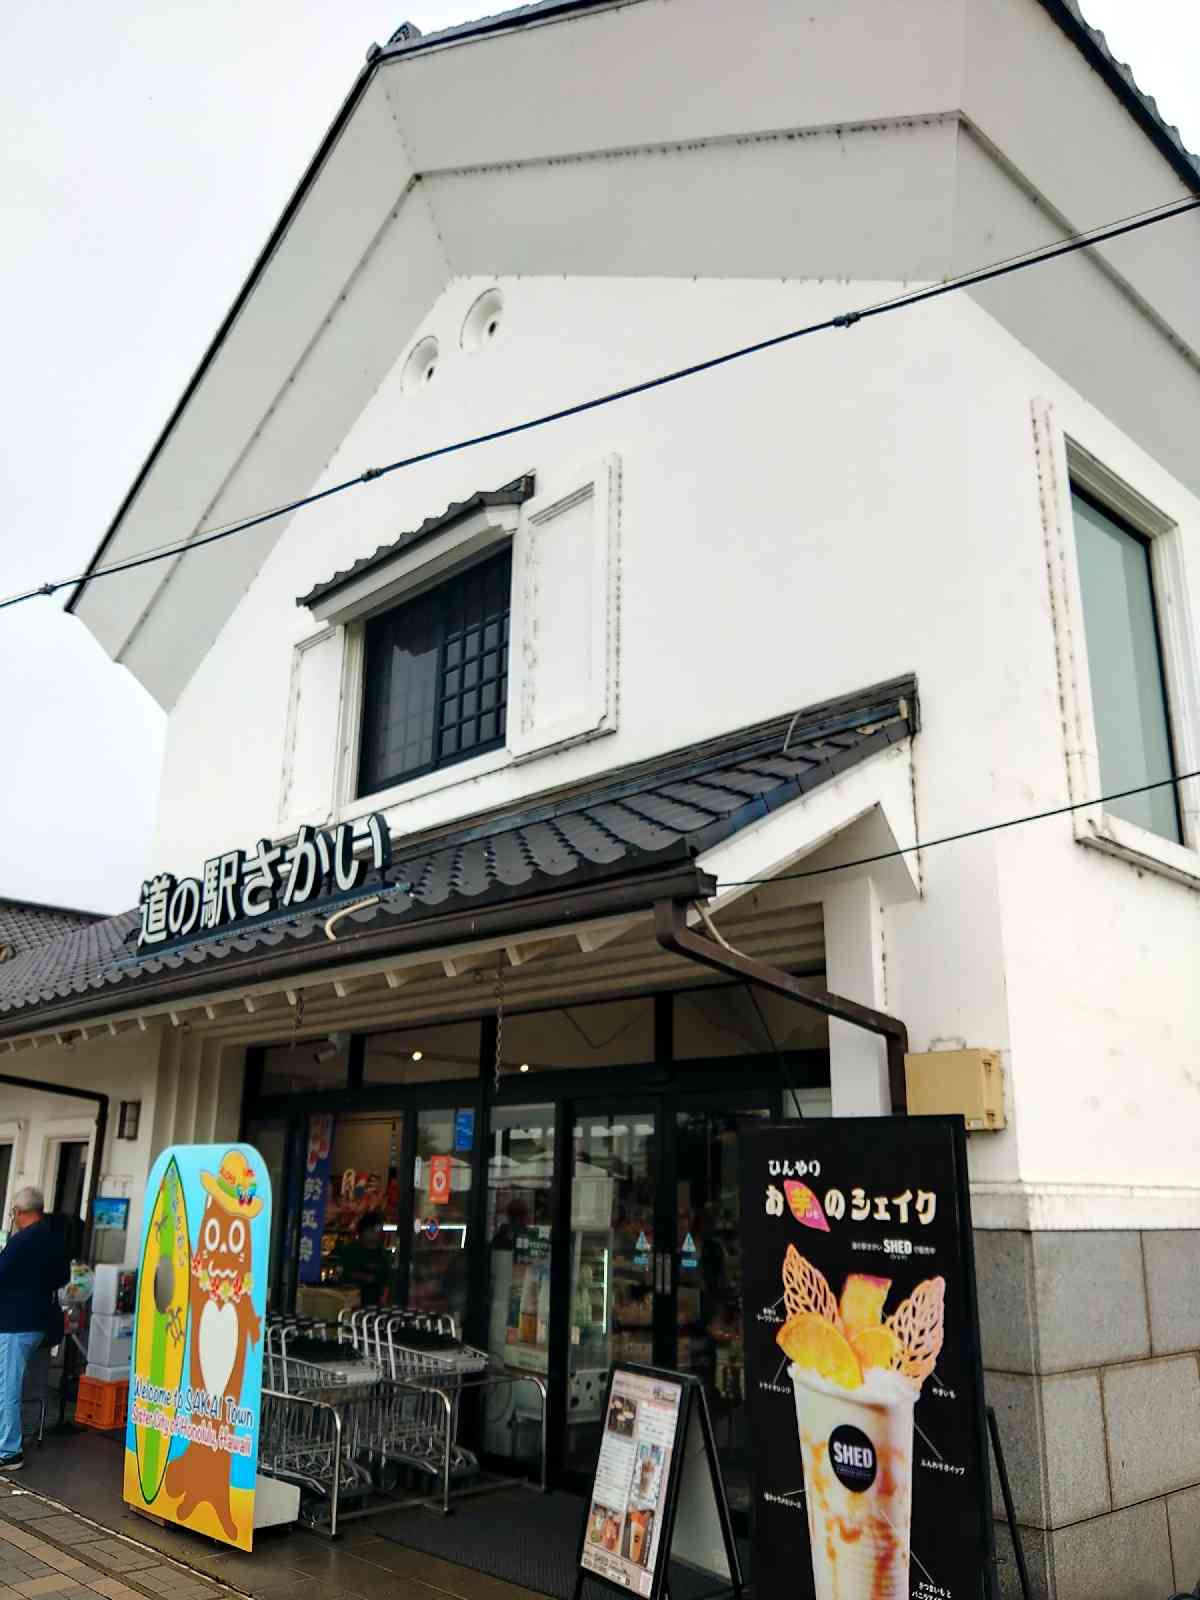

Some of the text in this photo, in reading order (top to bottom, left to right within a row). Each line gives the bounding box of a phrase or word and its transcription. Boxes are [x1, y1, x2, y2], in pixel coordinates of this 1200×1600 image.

[137, 813, 389, 947] 道の駅さかい
[768, 1159, 821, 1177] ひんやり
[883, 1239, 912, 1255] SHED
[135, 1376, 173, 1408] Welcome
[184, 1387, 223, 1420] SAKAI
[225, 1396, 255, 1428] Town
[833, 1441, 873, 1469] SHED
